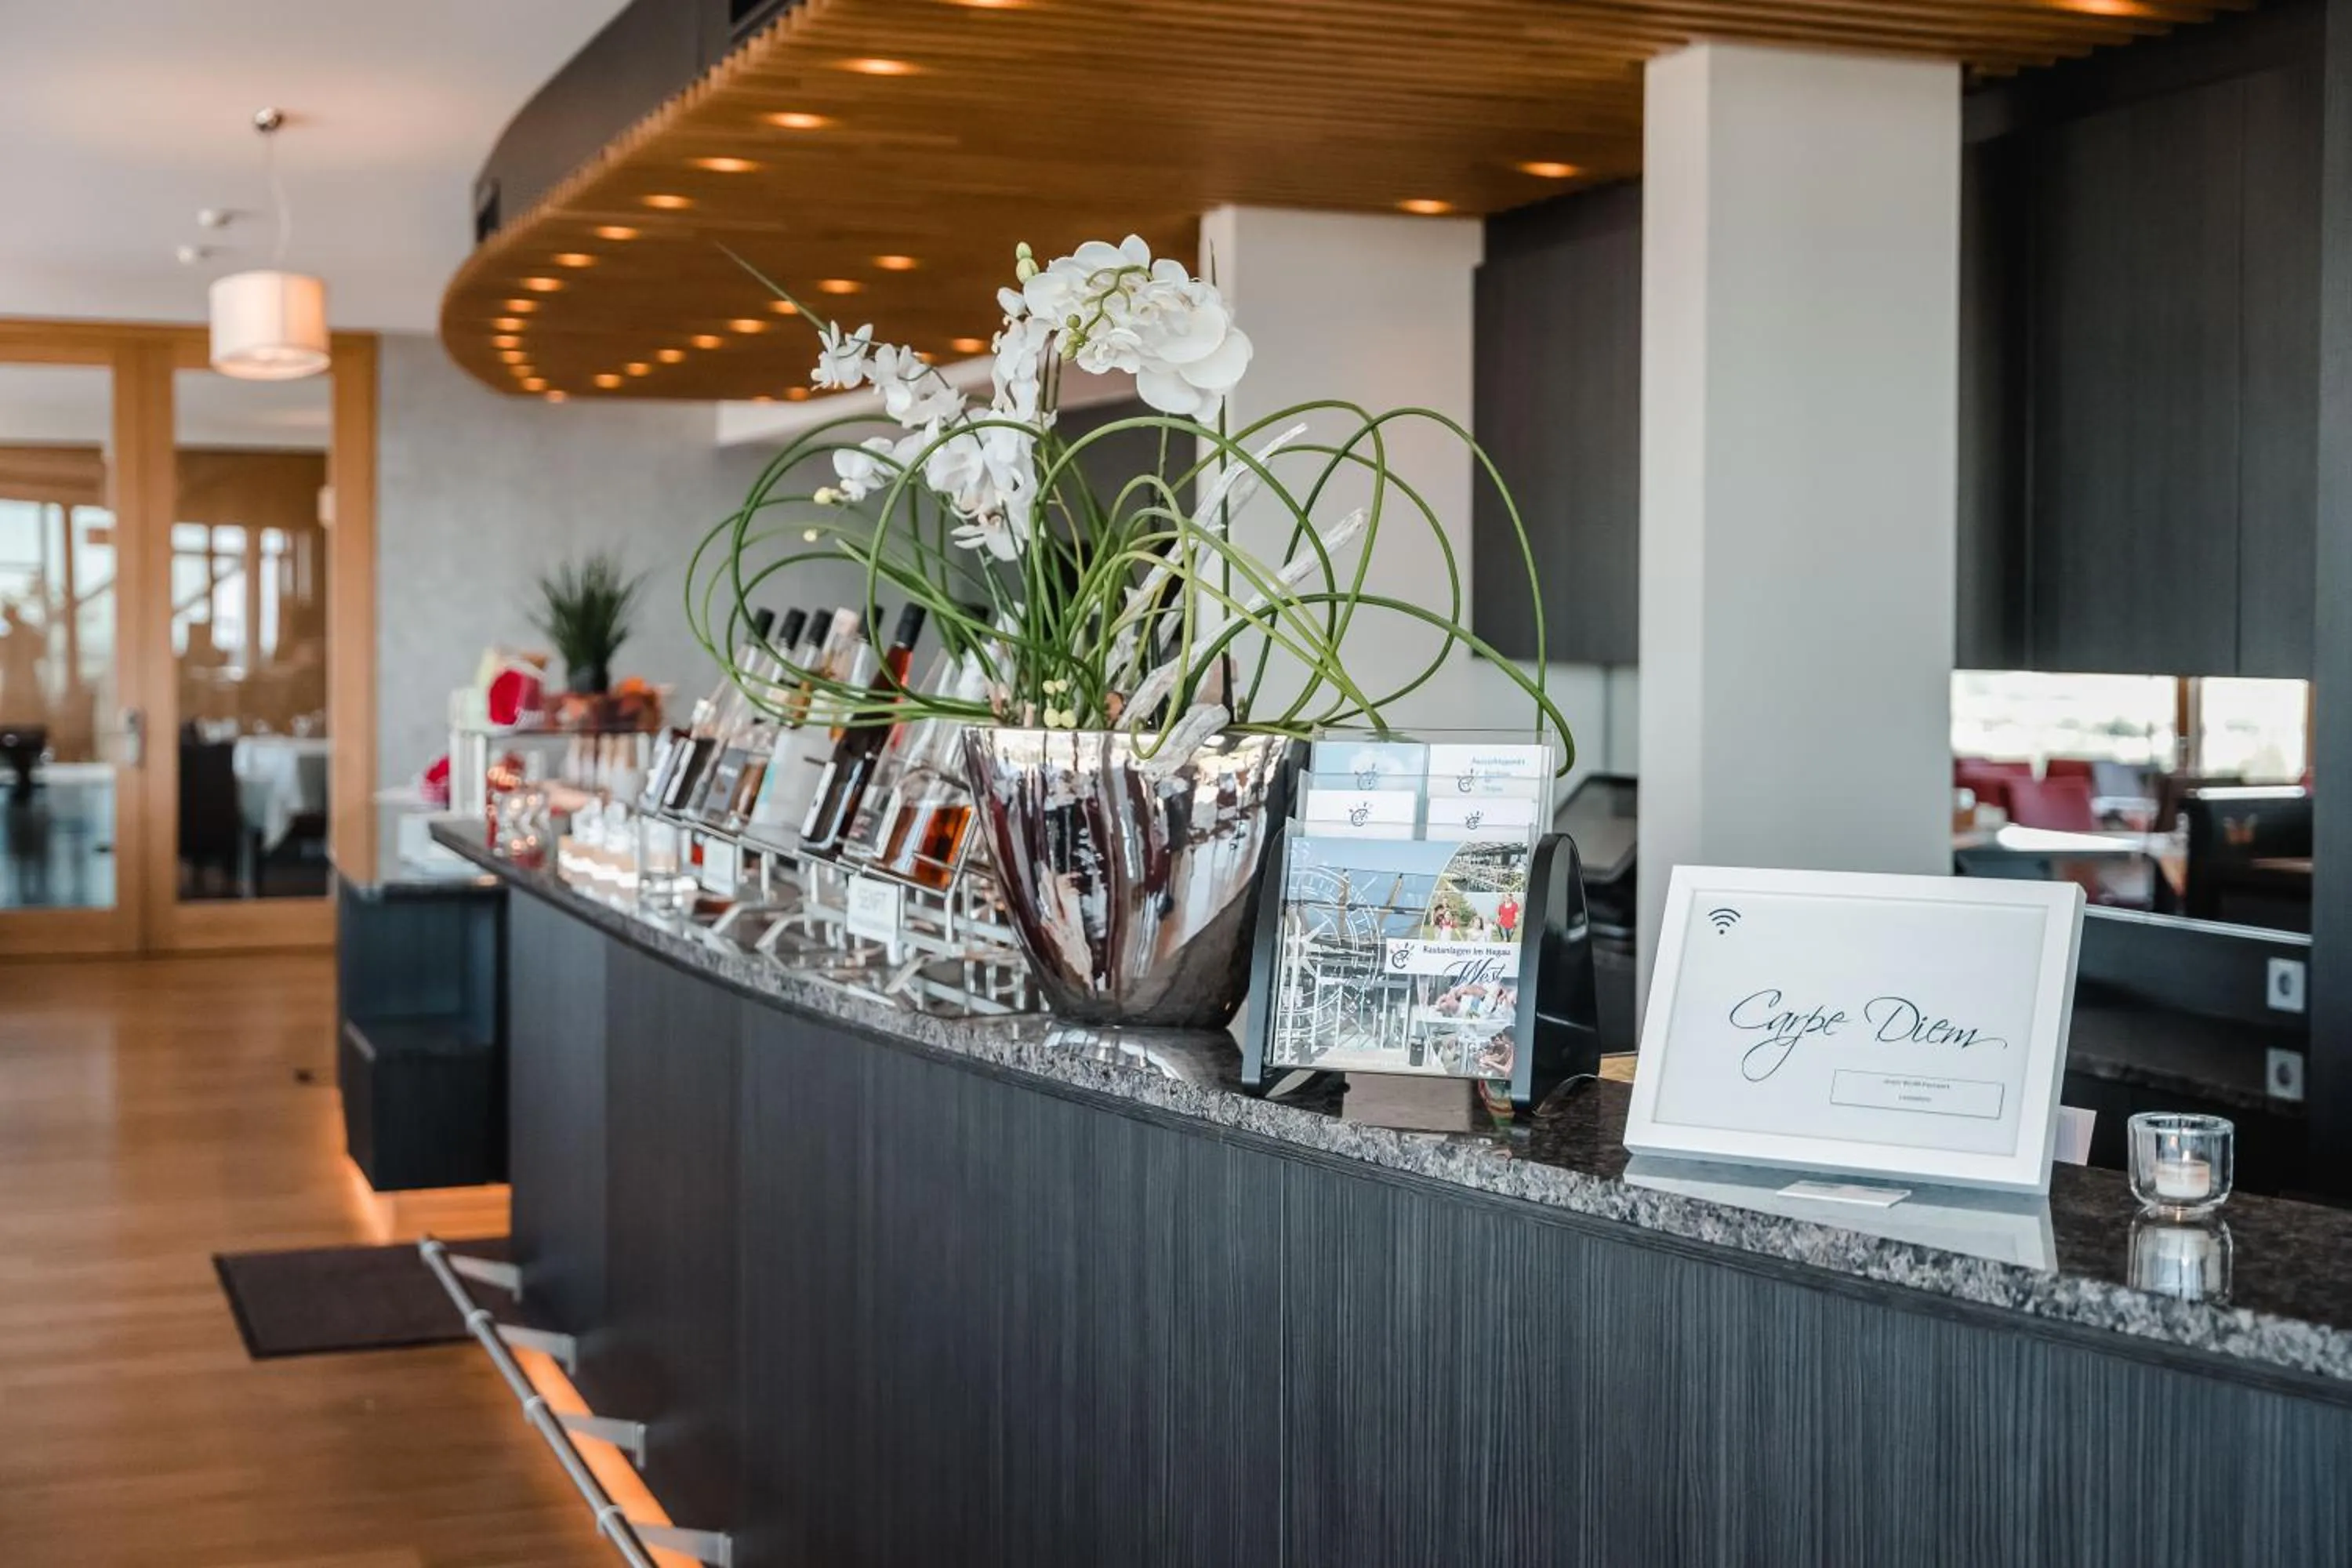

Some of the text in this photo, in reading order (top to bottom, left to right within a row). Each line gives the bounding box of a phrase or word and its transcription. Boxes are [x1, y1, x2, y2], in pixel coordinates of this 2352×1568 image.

[1443, 957, 1506, 986] West
[1730, 989, 2008, 1082] Carpe Diem
